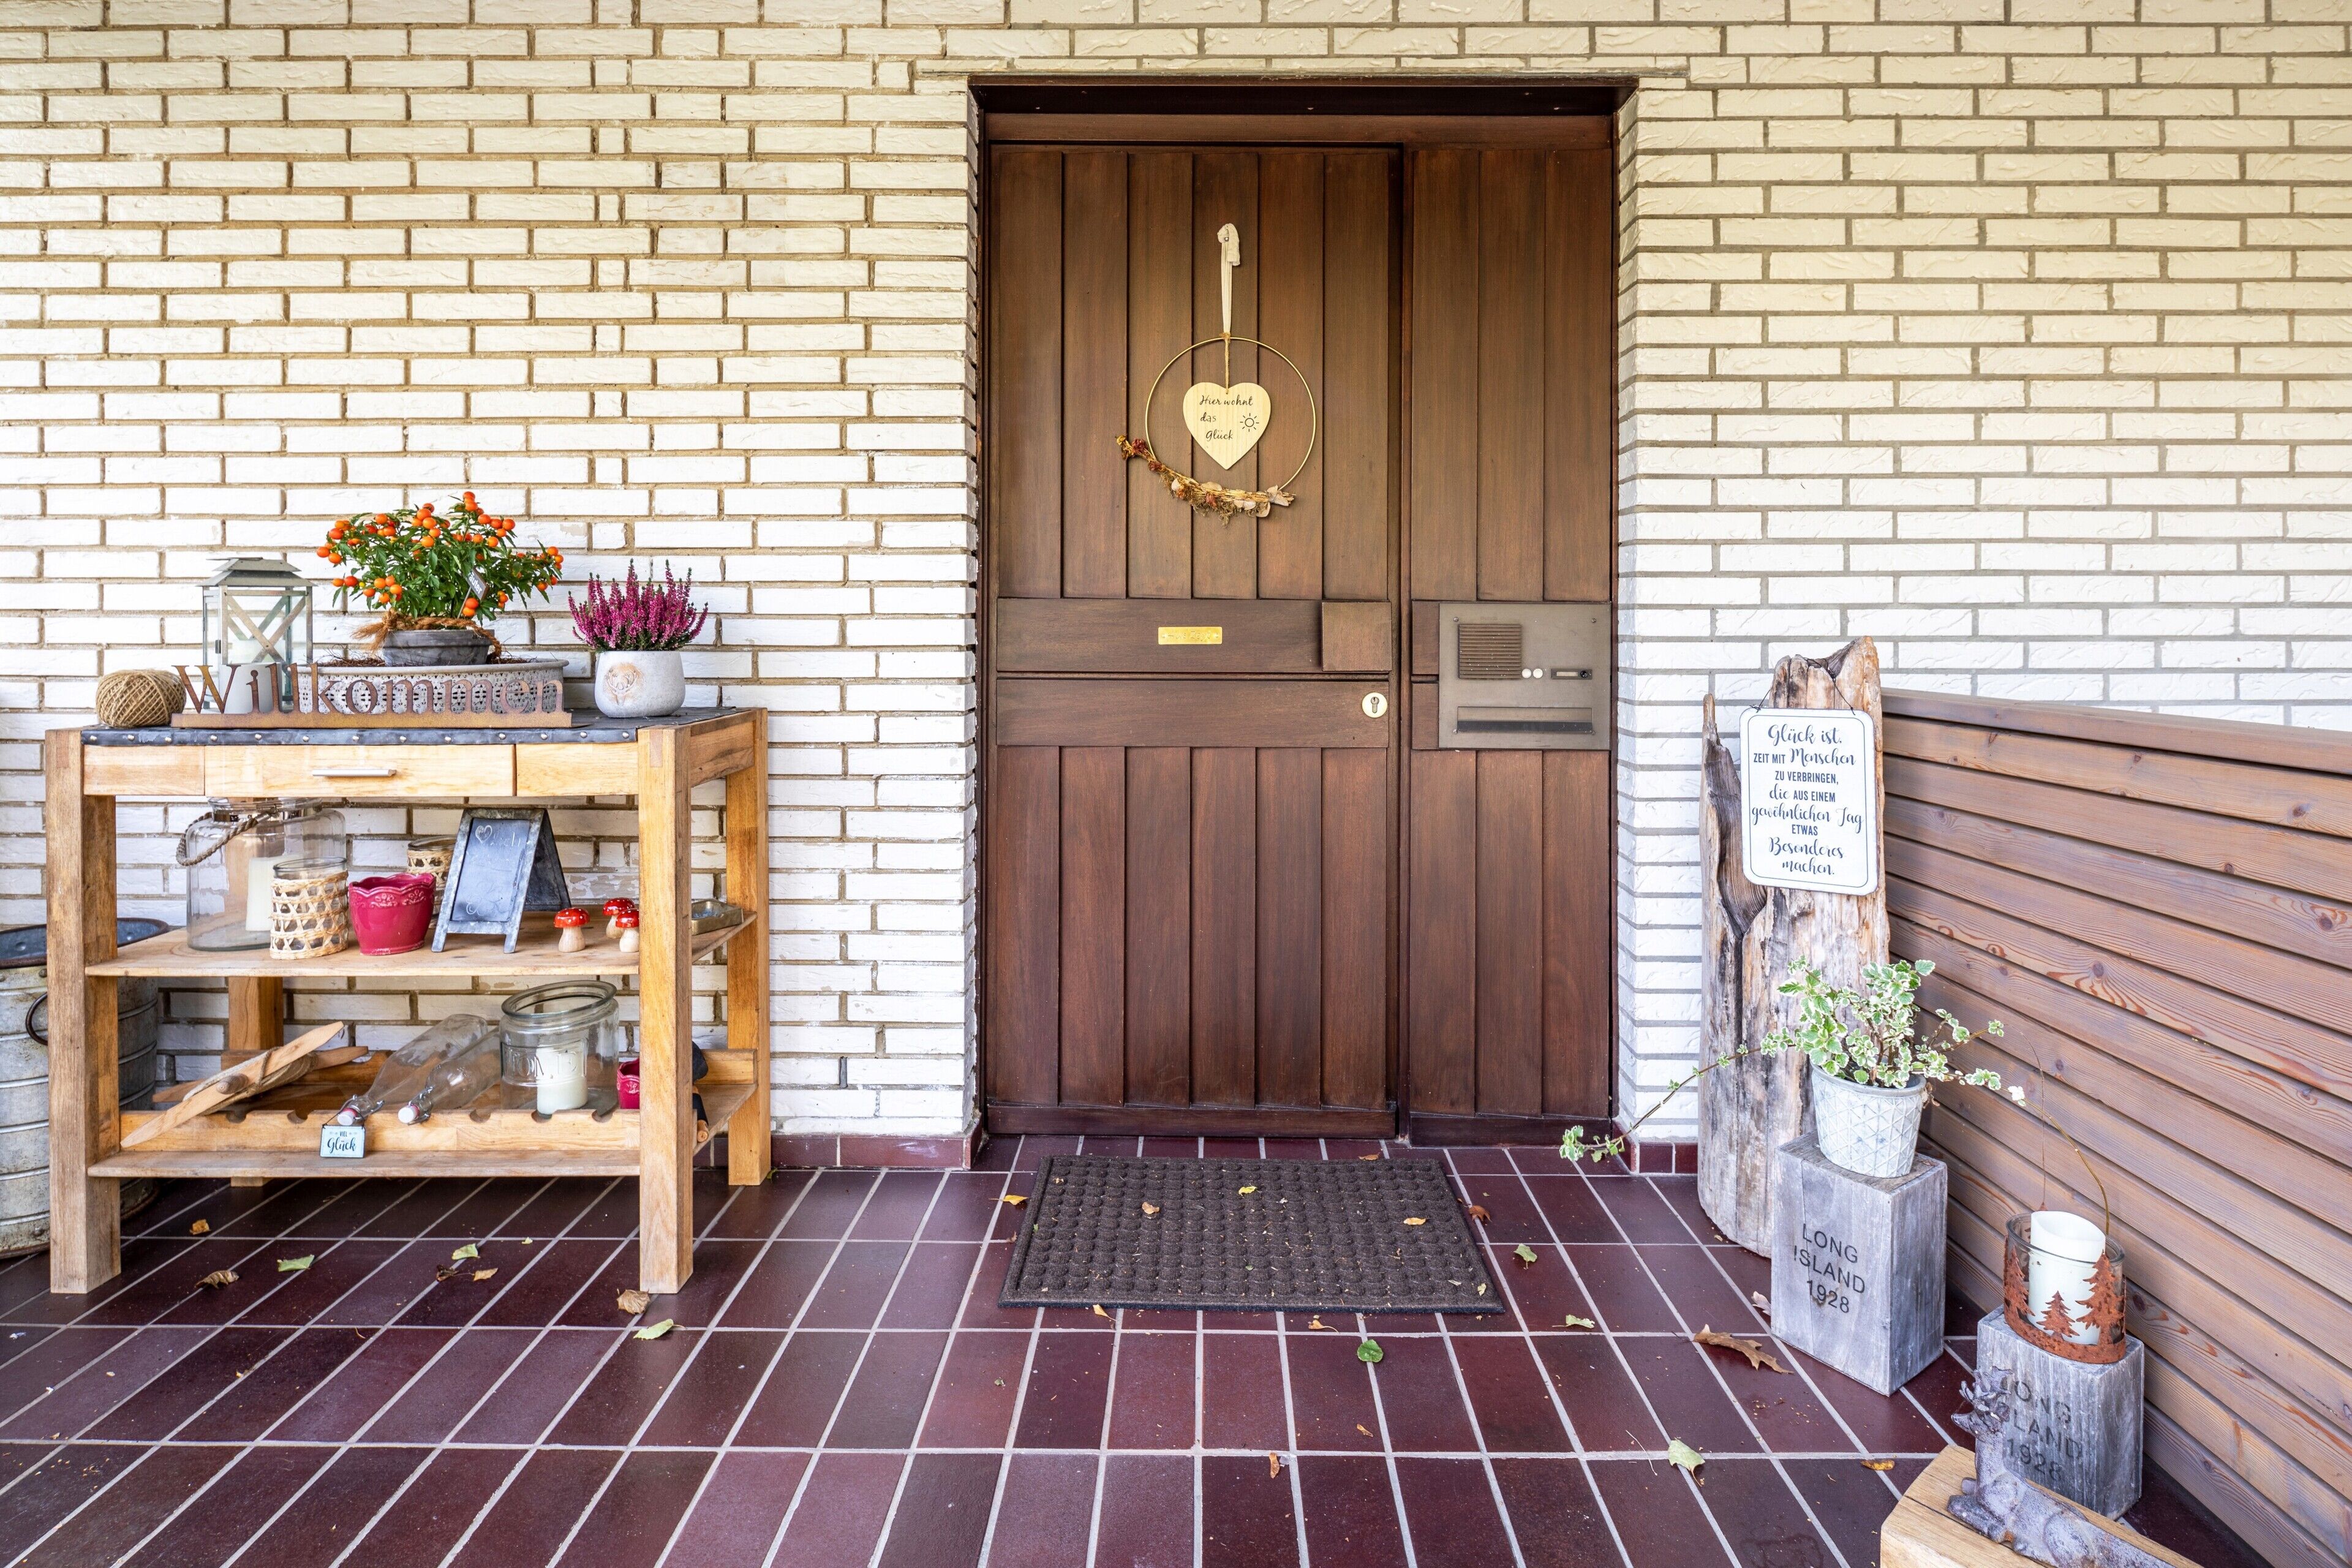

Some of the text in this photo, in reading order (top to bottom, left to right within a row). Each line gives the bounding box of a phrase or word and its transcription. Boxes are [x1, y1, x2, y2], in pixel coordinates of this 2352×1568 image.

[1199, 394, 1253, 405] Hier wohnt
[1200, 412, 1216, 423] das
[1205, 429, 1234, 442] Glück
[172, 663, 565, 714] Willkommen
[1768, 723, 1815, 746] Glück
[1754, 748, 1856, 767] ZEIT MIT Menschen
[1775, 771, 1839, 785] ZU VERBRINGEN,
[1769, 783, 1836, 803] die AUS EINEM
[1751, 802, 1863, 834] gewöhnlichen Tag
[1792, 824, 1818, 836] ETWAS
[1768, 837, 1844, 859] Besonderes
[1782, 858, 1835, 875] machen.
[327, 1137, 356, 1154] Glück
[1802, 1223, 1858, 1264] LONG
[1793, 1245, 1866, 1294] ISLAND
[1806, 1280, 1850, 1313] 1928
[2014, 1380, 2071, 1424] ONG
[2013, 1409, 2083, 1460] LAND
[2007, 1438, 2064, 1482] 1928
